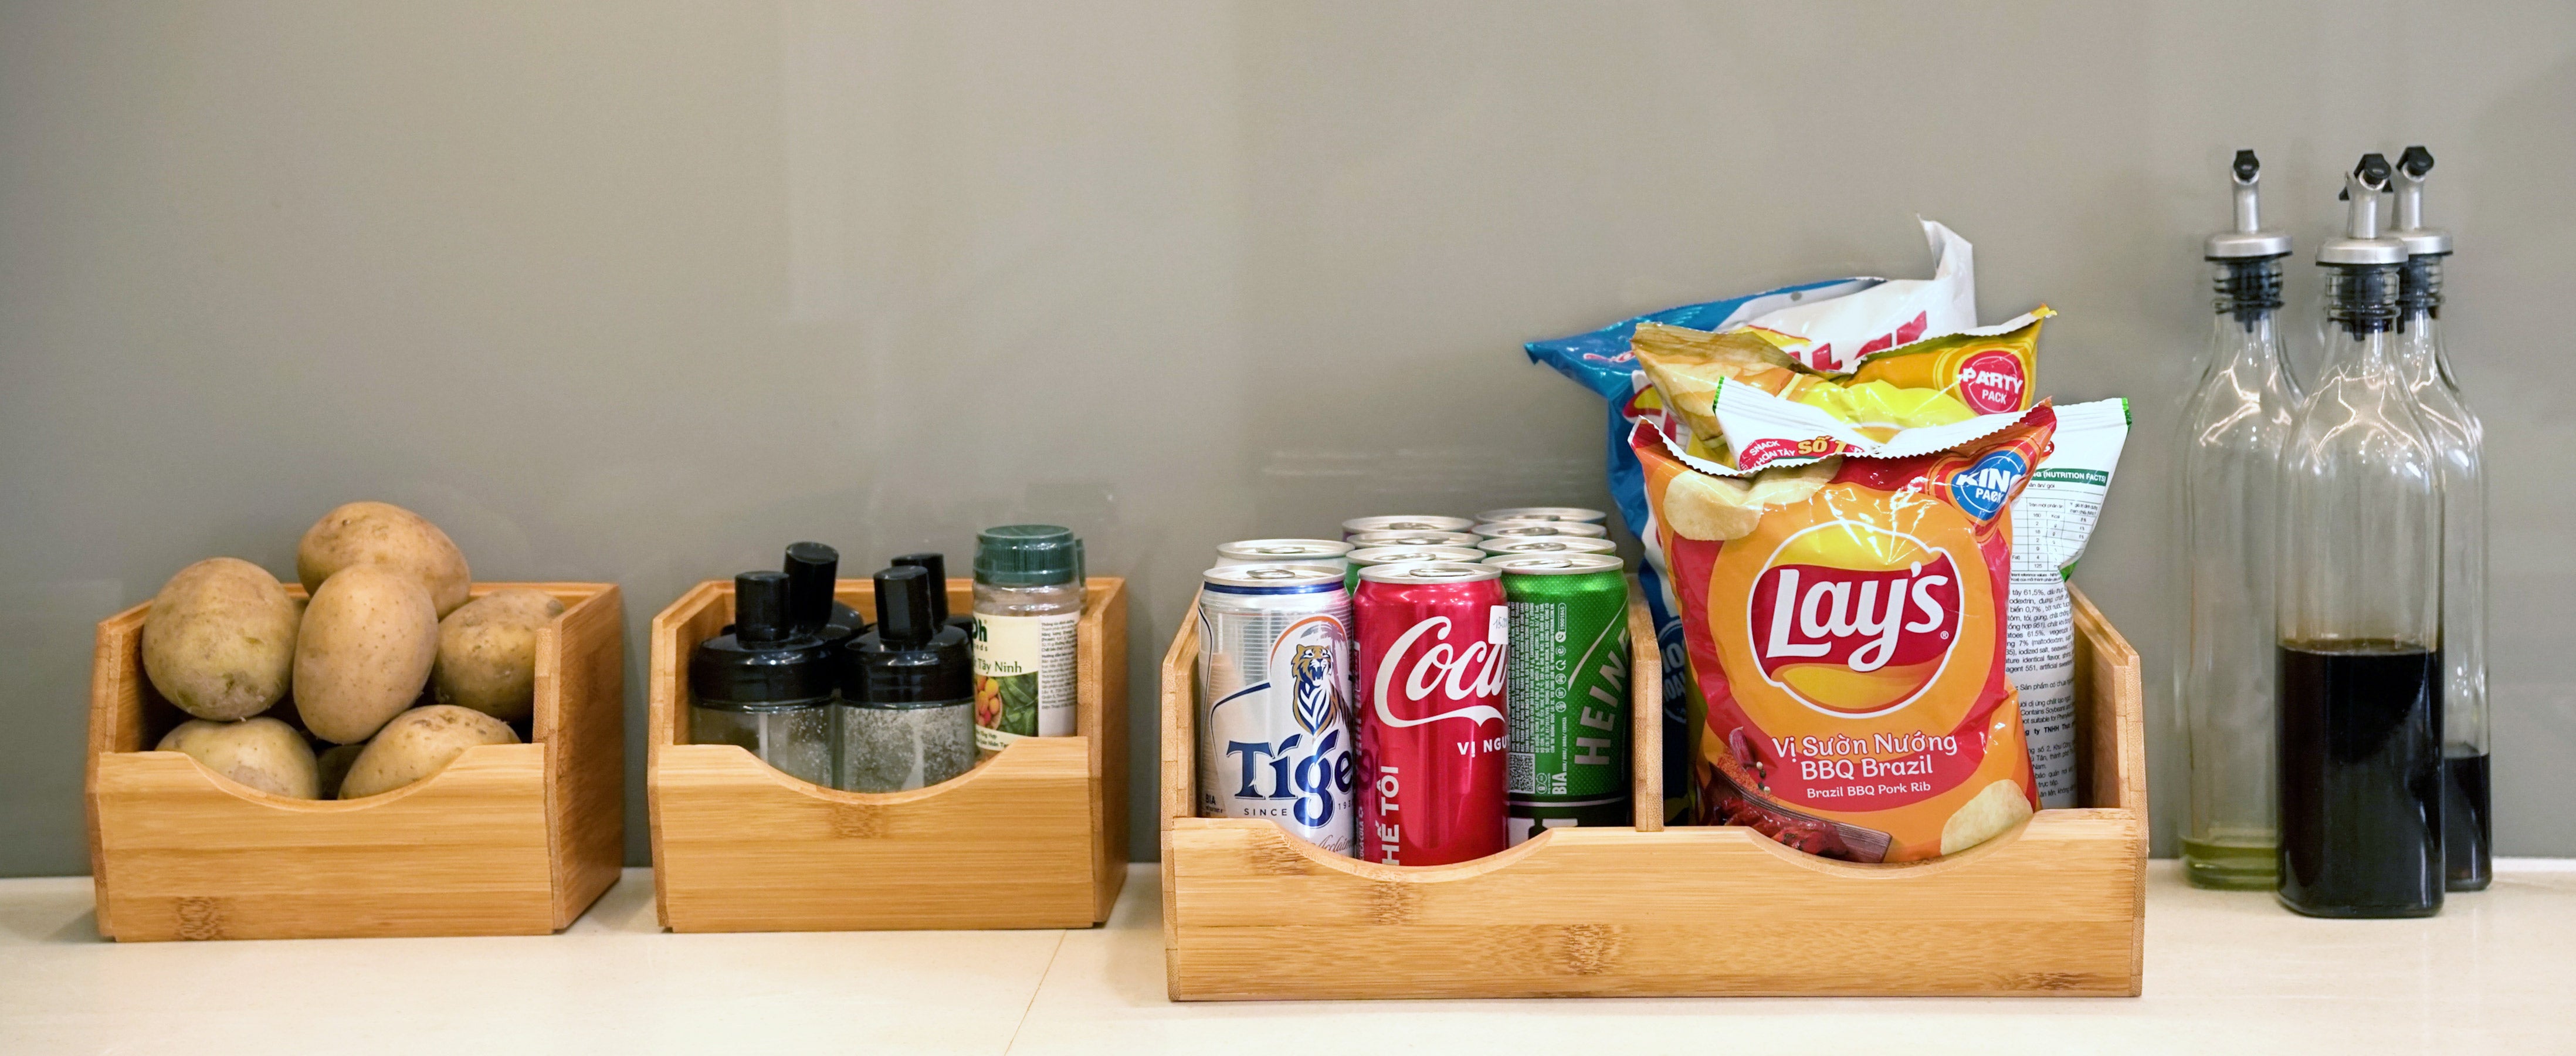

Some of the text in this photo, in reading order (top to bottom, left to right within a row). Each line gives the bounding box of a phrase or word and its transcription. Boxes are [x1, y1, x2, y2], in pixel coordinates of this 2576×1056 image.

[1962, 367, 2023, 394] PARTY
[1982, 389, 2006, 405] PACK
[1749, 440, 1780, 456] SNACK
[1778, 448, 1796, 457] TÂY
[1798, 435, 1833, 455] SỐ
[2043, 472, 2084, 480] (NUTRITION
[2086, 473, 2106, 483] FACTS)
[1766, 561, 1948, 672] Lay's
[2019, 647, 2038, 655] iodized
[978, 658, 1022, 675] Tây Ninh
[1457, 742, 1476, 758] VỊ
[1772, 730, 1958, 763] Vị Sườn Nướng
[1801, 754, 1933, 781] BBQ Brazil
[1376, 766, 1399, 816] TÔI
[1552, 772, 1567, 794] BIA
[1807, 781, 1931, 798] Brazil BBQ Pork Rib
[1244, 808, 1288, 817] SINCE
